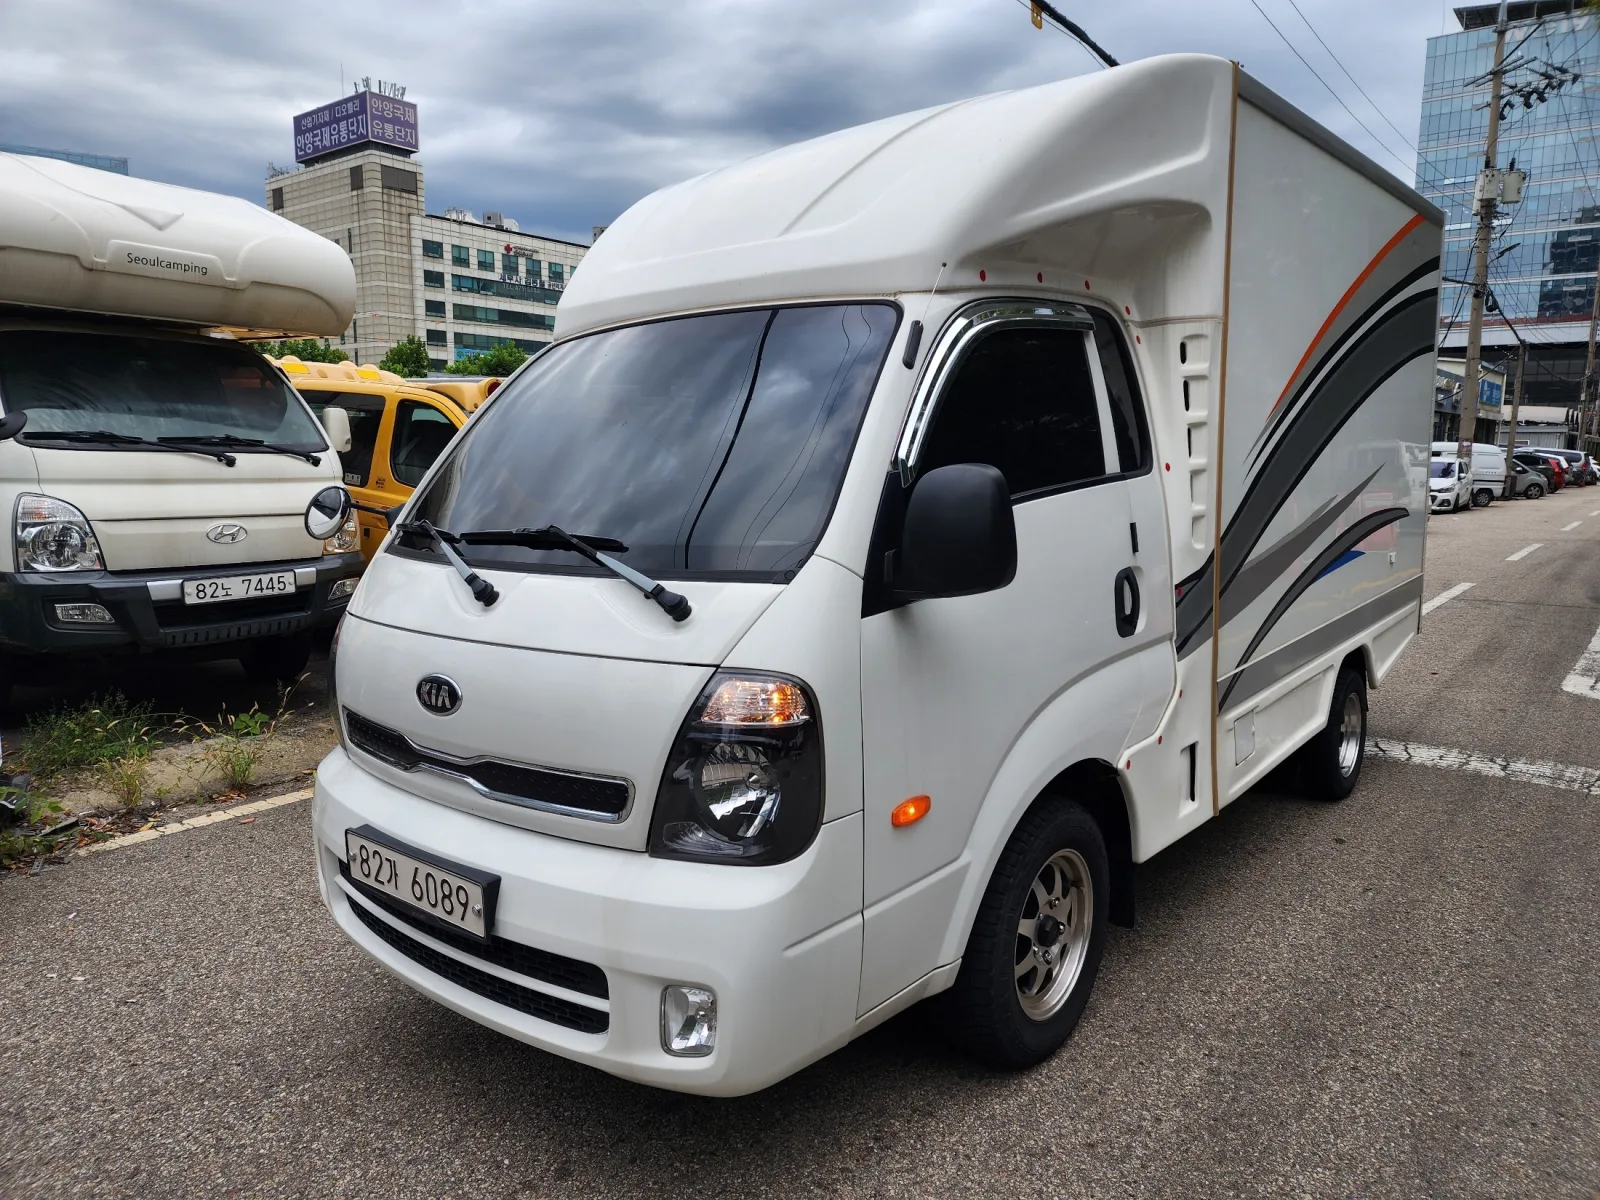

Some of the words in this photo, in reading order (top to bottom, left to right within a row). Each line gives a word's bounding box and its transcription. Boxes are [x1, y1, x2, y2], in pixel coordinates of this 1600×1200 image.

[301, 109, 330, 130] 산업기자재
[335, 99, 360, 118] 디오밸리
[371, 98, 415, 124] 안양국제
[296, 113, 367, 155] 안양국제유통단지
[373, 120, 416, 145] 유통단지
[126, 252, 208, 276] Seoulcamping
[195, 581, 233, 600] 82노
[241, 575, 287, 595] 7445
[420, 681, 451, 709] KIA
[360, 844, 399, 891] 82가
[411, 866, 469, 922] 6089
